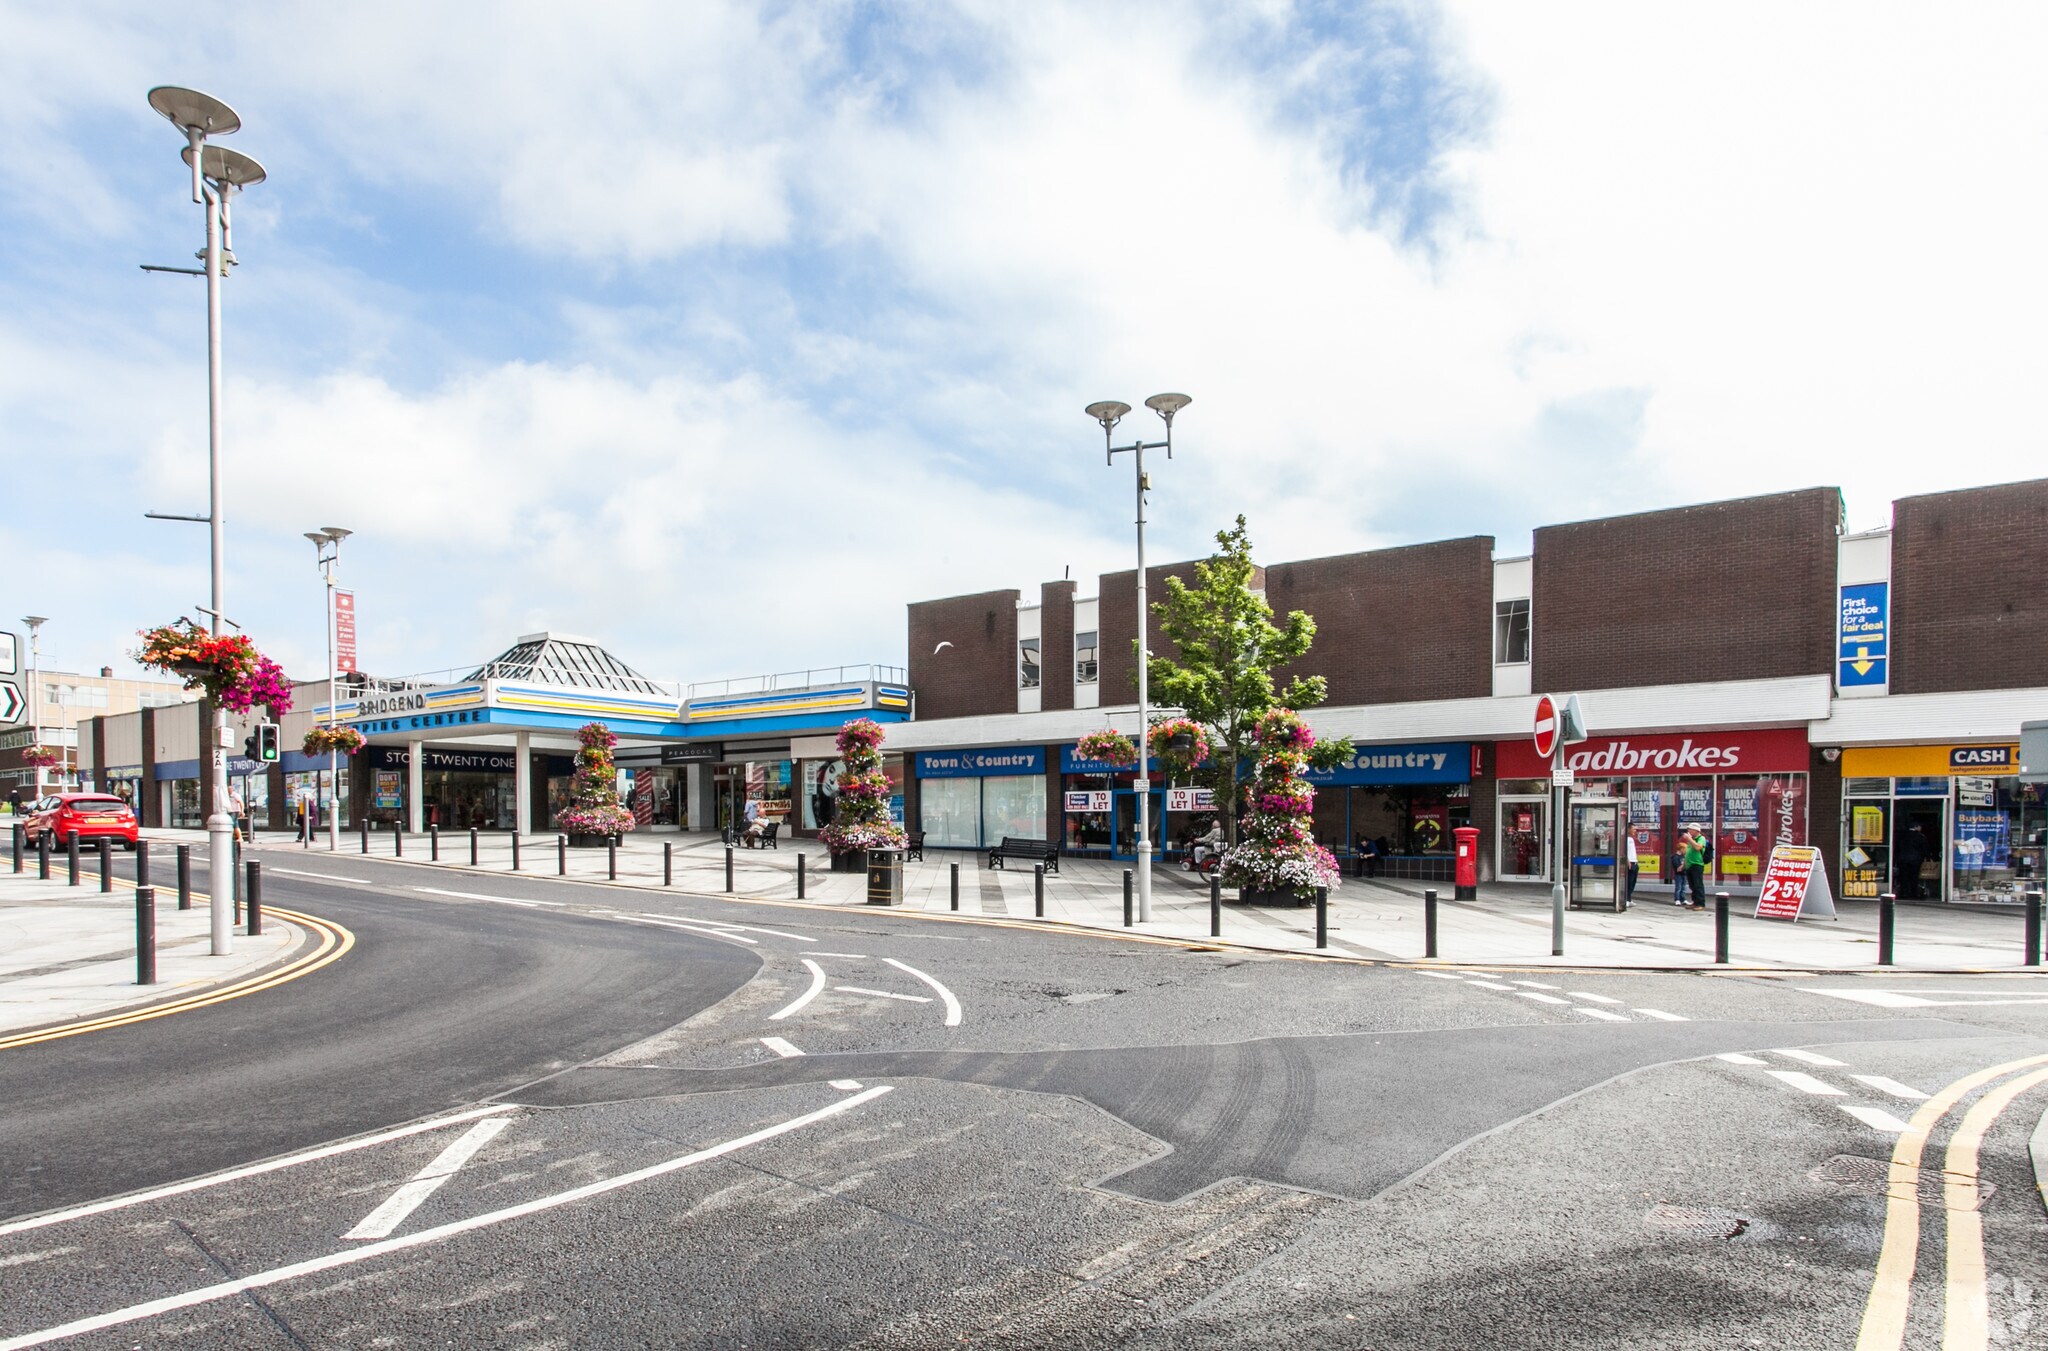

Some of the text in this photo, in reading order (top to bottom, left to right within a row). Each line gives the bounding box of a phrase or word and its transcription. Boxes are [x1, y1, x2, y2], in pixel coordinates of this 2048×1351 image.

[1843, 598, 1866, 607] First
[1843, 606, 1878, 616] choice
[1843, 616, 1857, 624] for
[1843, 621, 1883, 632] fair deal
[359, 694, 424, 715] BRIDGEND
[410, 711, 480, 727] CENTRE
[1954, 750, 2005, 762] CASH
[233, 761, 255, 770] TWENTY
[432, 755, 486, 766] TWENTY
[490, 757, 515, 768] ONE
[925, 754, 1035, 769] Town & Country
[1173, 791, 1186, 799] TO
[1680, 790, 1710, 800] MONEY
[1726, 789, 1756, 800] MONEY
[1684, 800, 1706, 810] BACK
[1728, 800, 1753, 810] BACK
[1959, 814, 2004, 823] Buyback
[1772, 860, 1811, 869] Cheques
[1770, 868, 1808, 878] Cashed
[1844, 870, 1876, 880] WE BUY
[1844, 882, 1877, 896] GOLD
